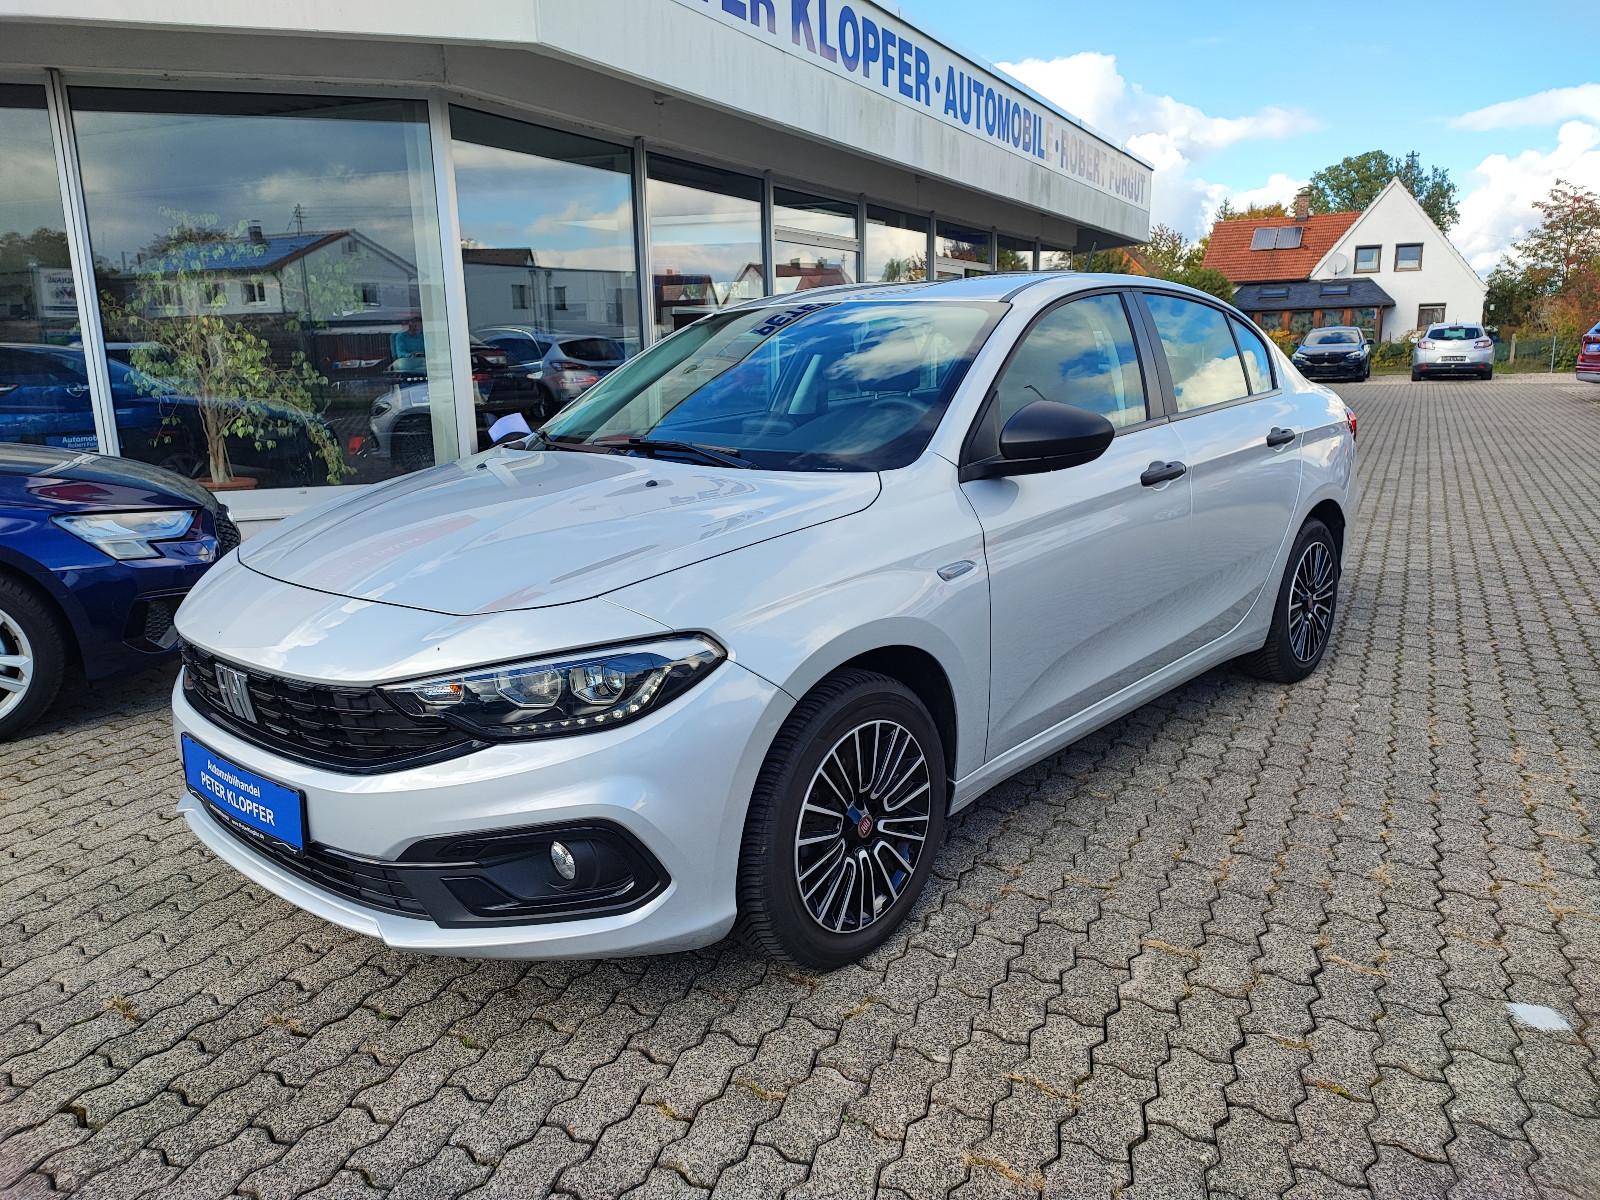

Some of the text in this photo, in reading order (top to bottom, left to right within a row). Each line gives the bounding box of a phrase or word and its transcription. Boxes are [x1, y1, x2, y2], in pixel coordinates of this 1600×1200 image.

[791, 0, 931, 107] KLOPFER
[200, 770, 226, 801] PETER
[226, 788, 276, 827] KLOPFER
[207, 759, 261, 798] Automobilhandel
